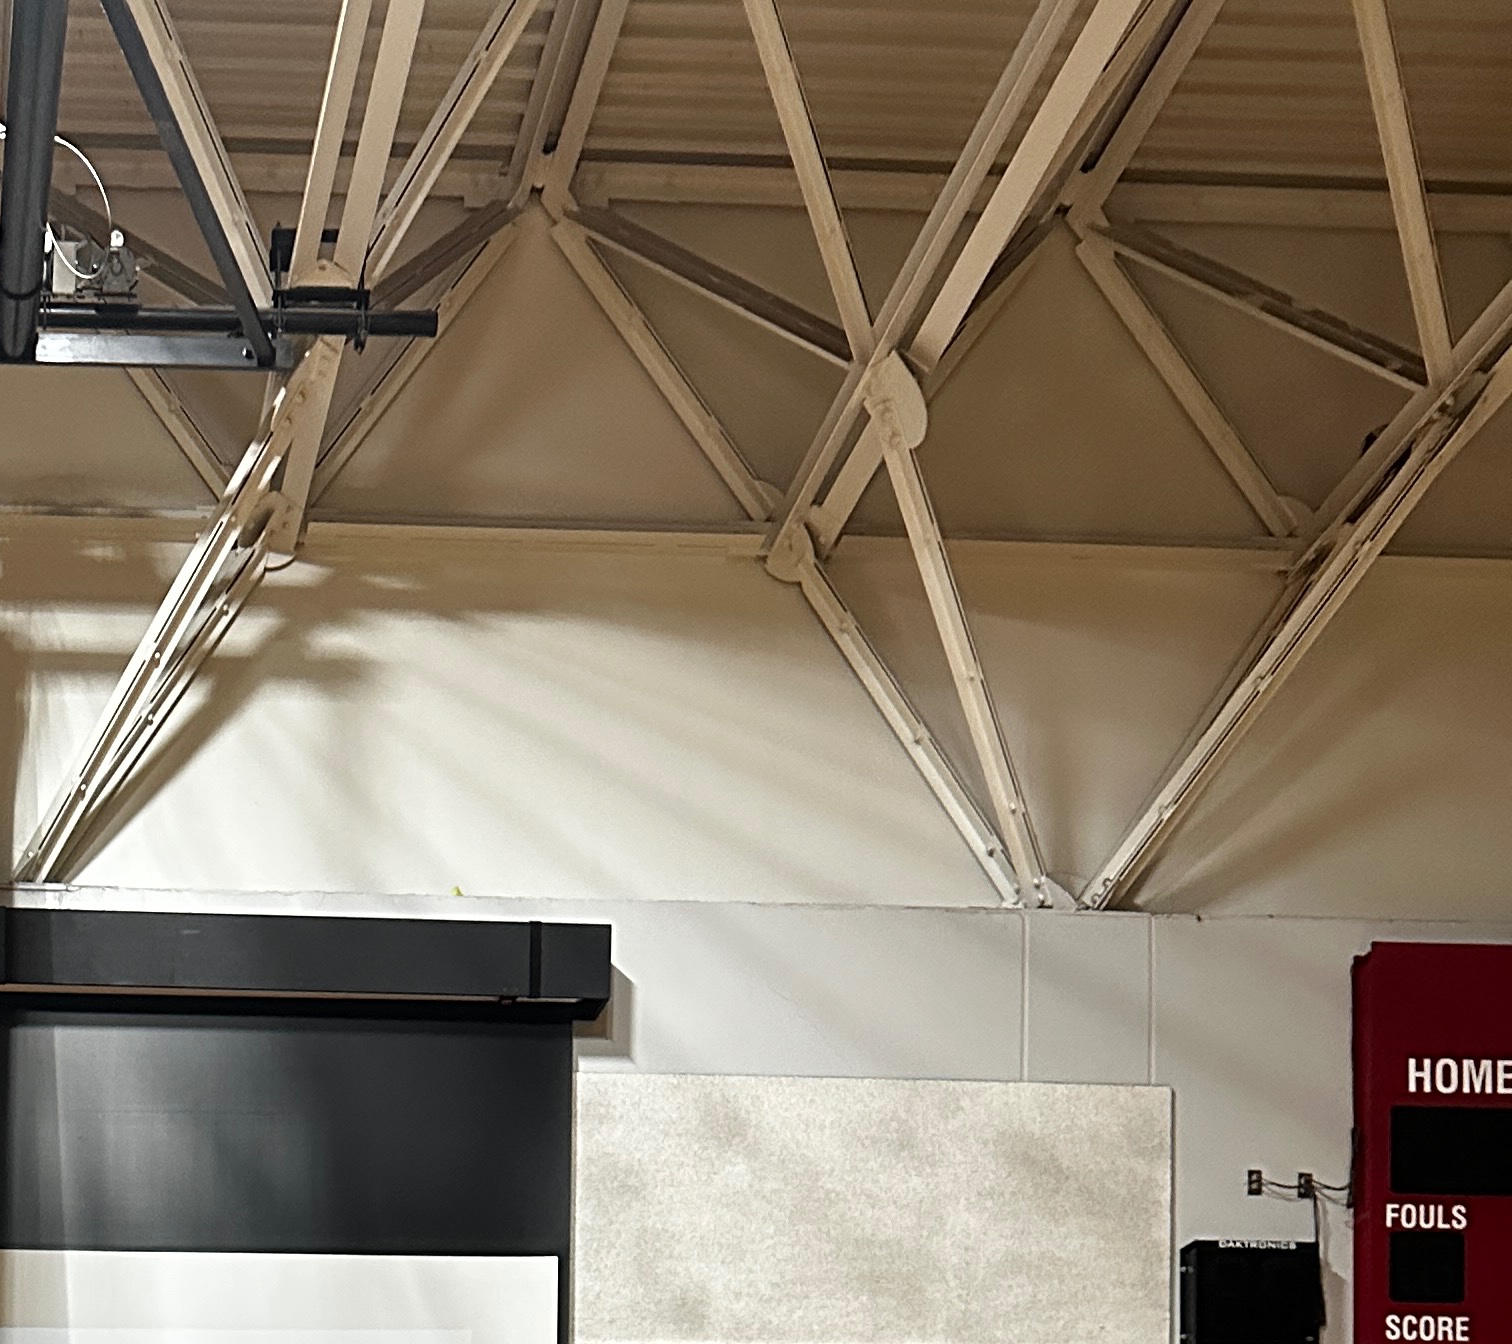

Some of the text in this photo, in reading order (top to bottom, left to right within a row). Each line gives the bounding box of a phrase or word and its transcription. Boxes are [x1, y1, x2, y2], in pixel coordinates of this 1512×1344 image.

[1407, 1057, 1512, 1094] HOME
[1385, 1203, 1467, 1229] FOULS
[1385, 1314, 1470, 1342] SCORE
